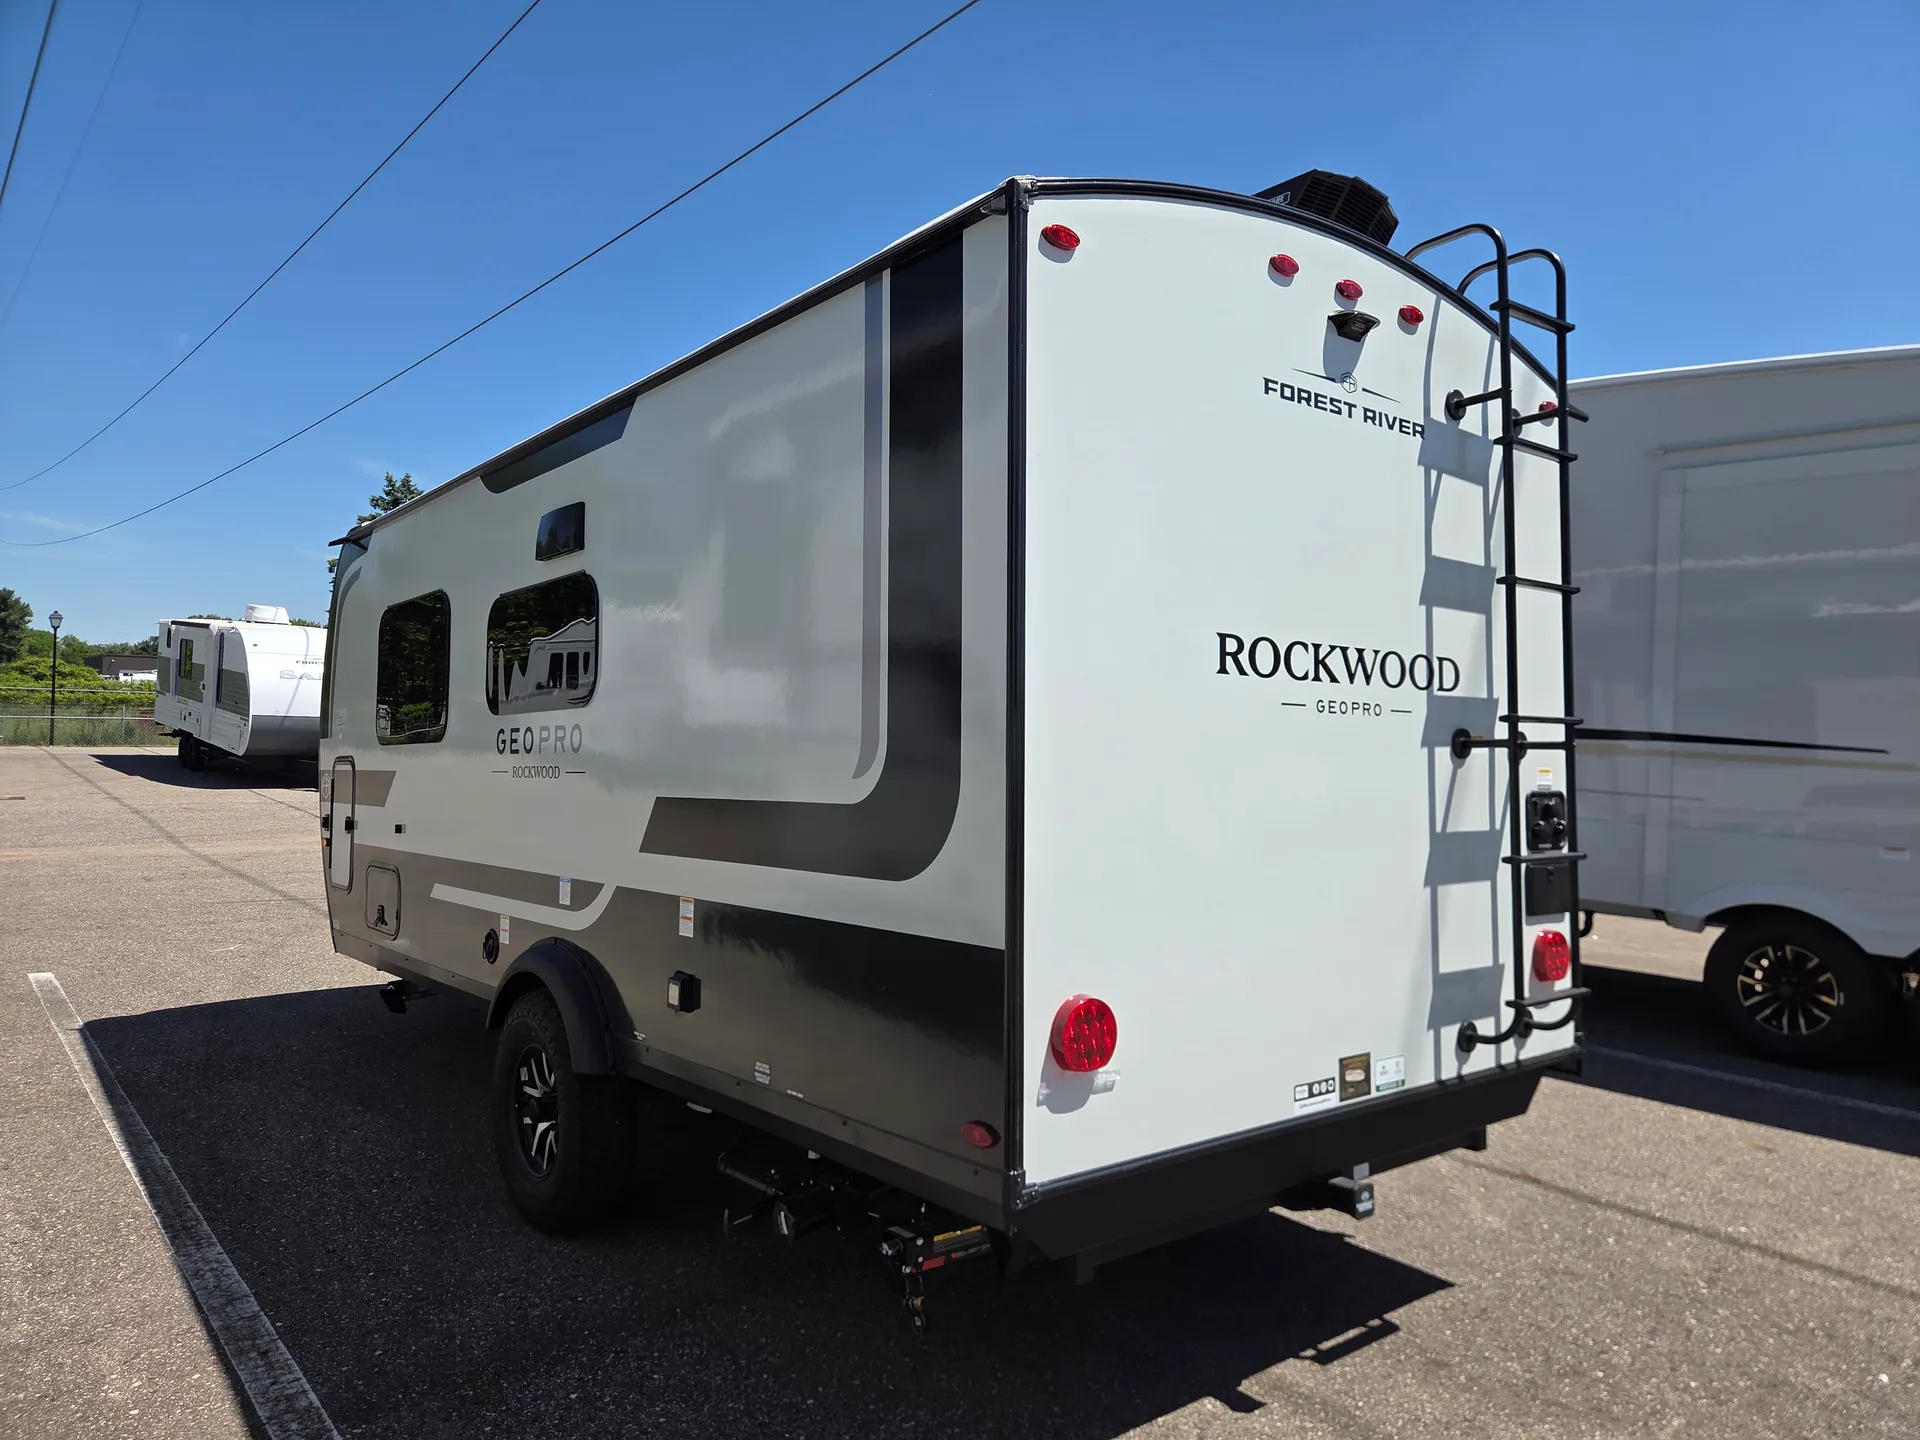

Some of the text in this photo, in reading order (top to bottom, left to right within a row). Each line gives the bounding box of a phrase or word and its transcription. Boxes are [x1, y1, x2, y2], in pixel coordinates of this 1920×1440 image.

[1263, 377, 1426, 440] FOREST RIVER
[1215, 632, 1461, 692] ROCKWOOD
[1316, 699, 1383, 717] GEOPRO
[496, 723, 583, 755] GEOPRO
[512, 765, 560, 779] ROCKWOOD
